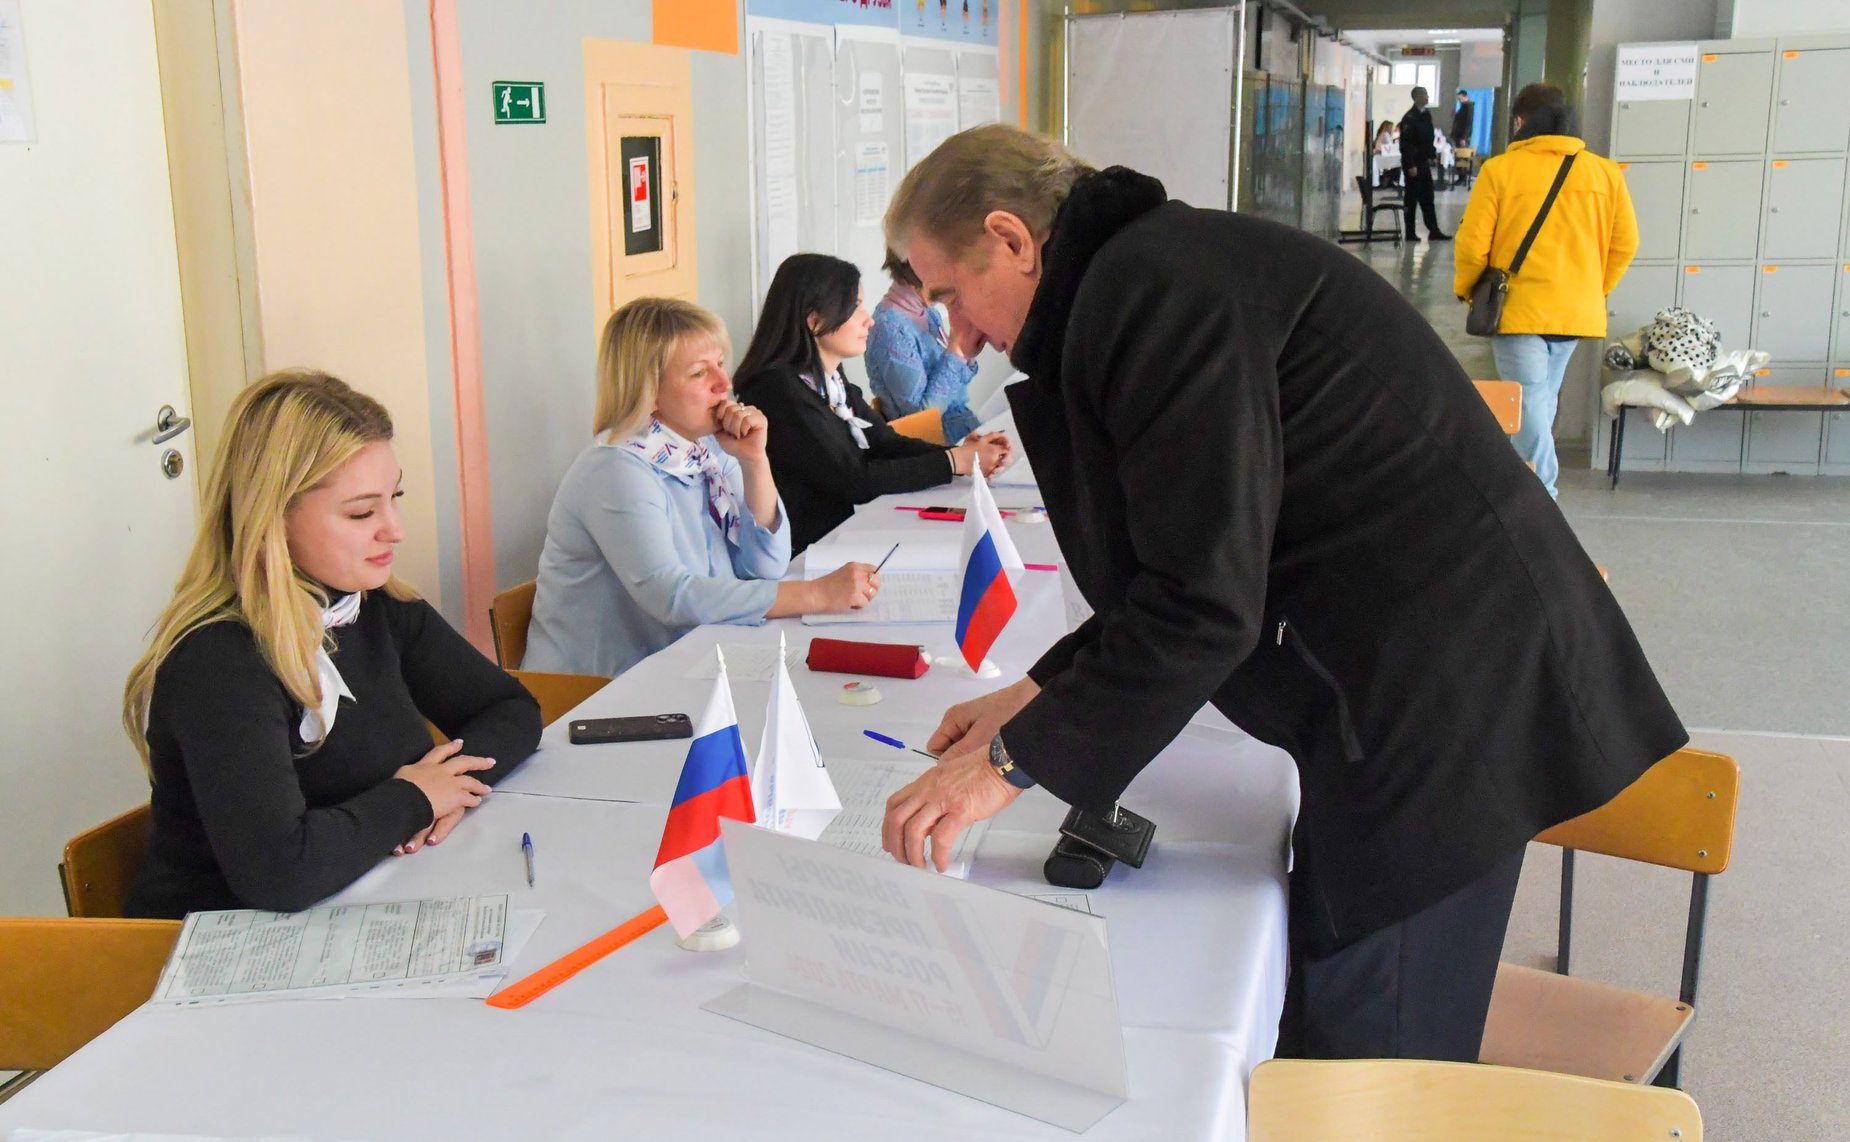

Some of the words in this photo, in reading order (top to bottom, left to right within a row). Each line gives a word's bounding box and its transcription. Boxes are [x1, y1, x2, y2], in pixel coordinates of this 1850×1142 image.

[1621, 58, 1653, 66] МЕСТО
[1656, 57, 1672, 65] ДЛЯ
[1674, 56, 1695, 65] СМИ
[1619, 78, 1693, 88] НАБЛЮДАТЕЛЕЙ
